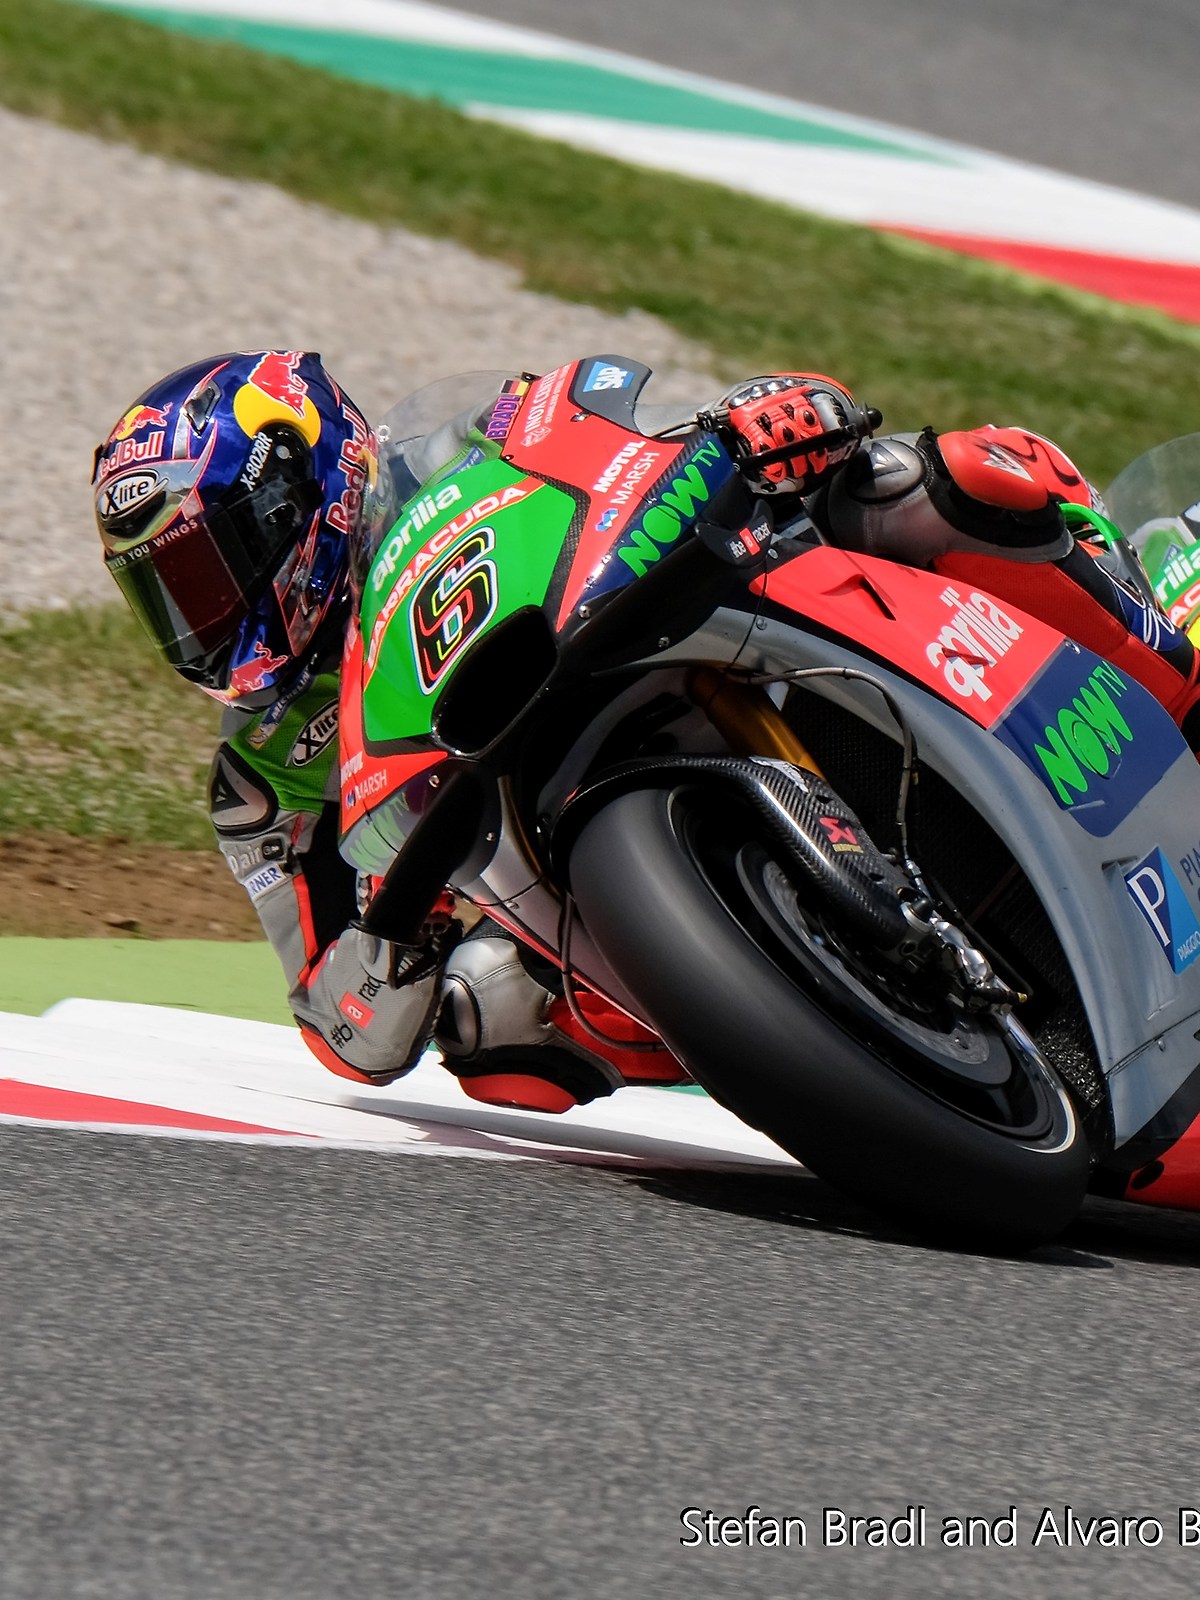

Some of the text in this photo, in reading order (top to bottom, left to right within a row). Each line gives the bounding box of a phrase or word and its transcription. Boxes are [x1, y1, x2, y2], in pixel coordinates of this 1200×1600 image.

[484, 394, 523, 440] BRADL
[99, 442, 121, 478] ed
[239, 432, 273, 491] X-802RR
[592, 440, 648, 494] MOTUL
[610, 452, 661, 505] MARSH
[103, 481, 149, 515] X-lite
[617, 440, 722, 579] NOW TV
[128, 543, 151, 560] YOU
[153, 518, 198, 548] WINGS
[372, 483, 463, 592] aprilia
[408, 526, 498, 696] 6
[926, 586, 1024, 702] aprilia
[1034, 659, 1135, 805] NOW TV
[355, 769, 388, 801] MARSH
[1127, 866, 1171, 947] P
[346, 1004, 364, 1020] a
